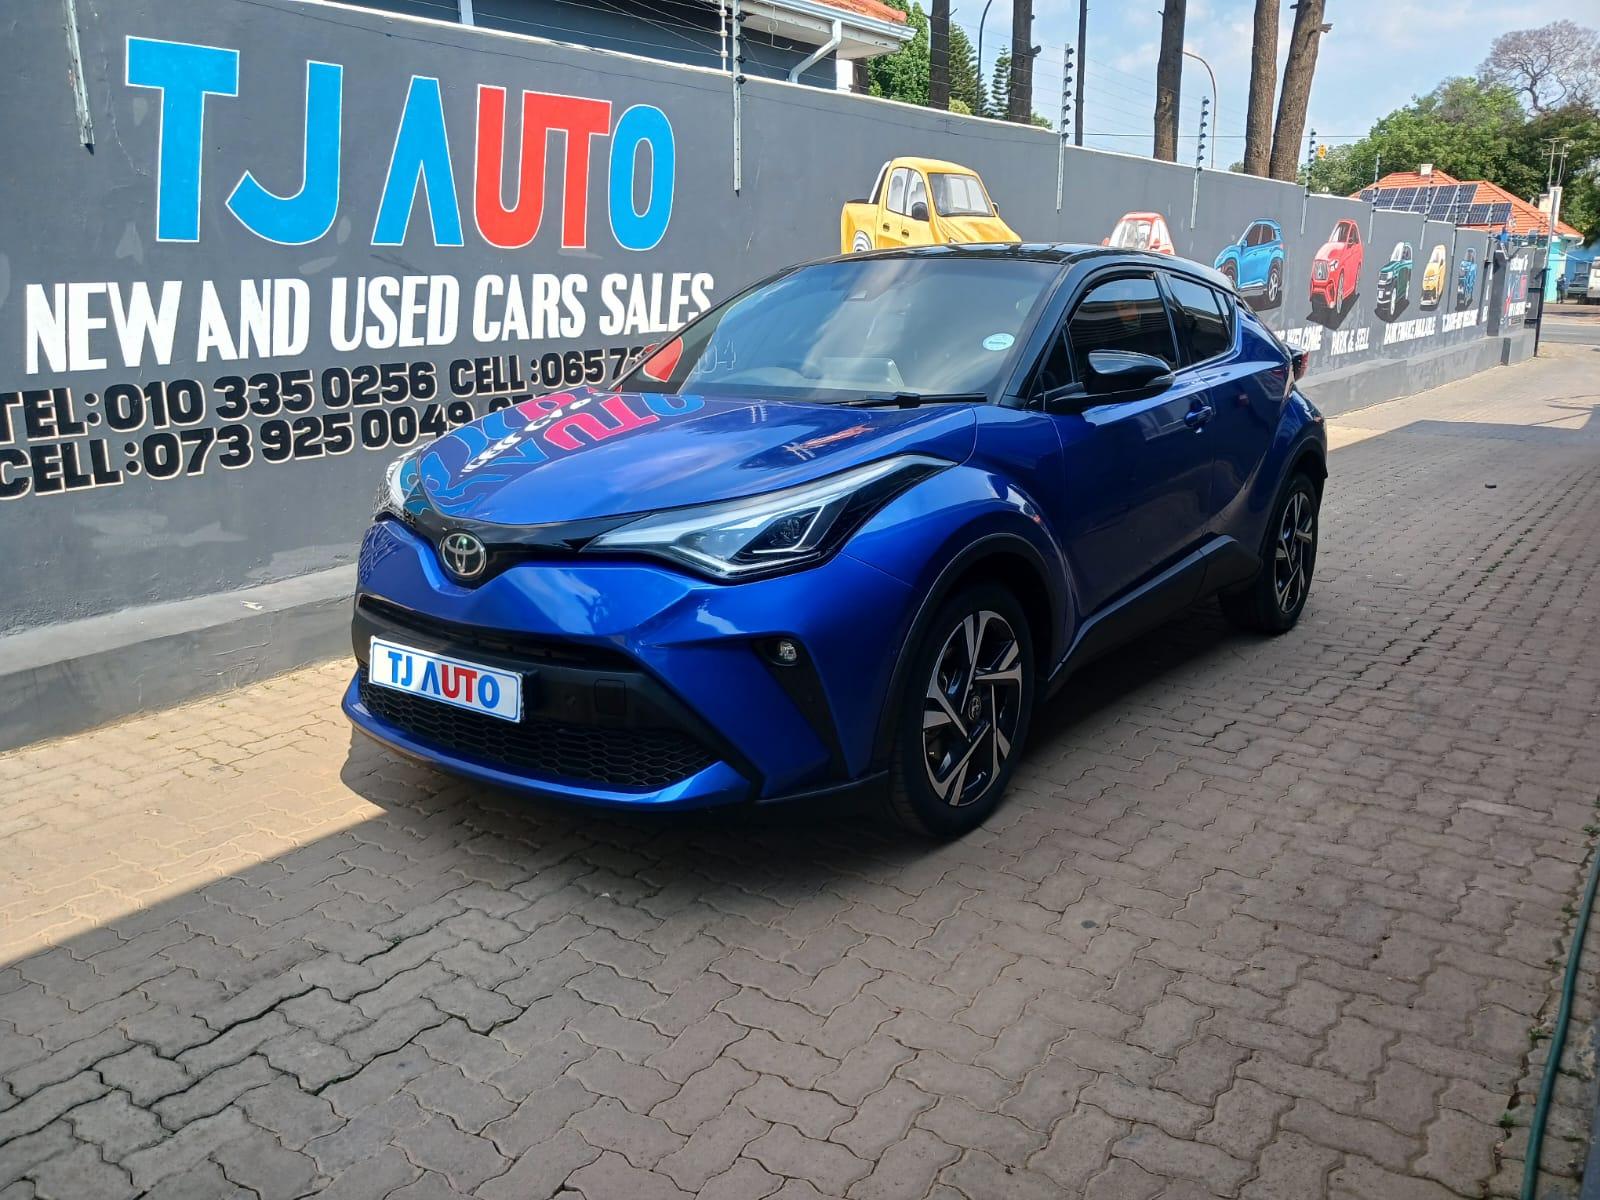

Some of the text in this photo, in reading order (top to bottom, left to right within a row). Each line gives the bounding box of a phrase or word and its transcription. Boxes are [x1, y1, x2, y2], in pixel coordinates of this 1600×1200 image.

[125, 36, 676, 251] TJ AUTO
[26, 272, 714, 375] NEW AND USED CARS SALES
[1331, 330, 1349, 356] PARK
[213, 369, 315, 421] 335
[321, 361, 438, 411] 0256
[260, 413, 355, 464] 925
[361, 401, 476, 450] 0049
[388, 651, 500, 709] TJ AUTO
